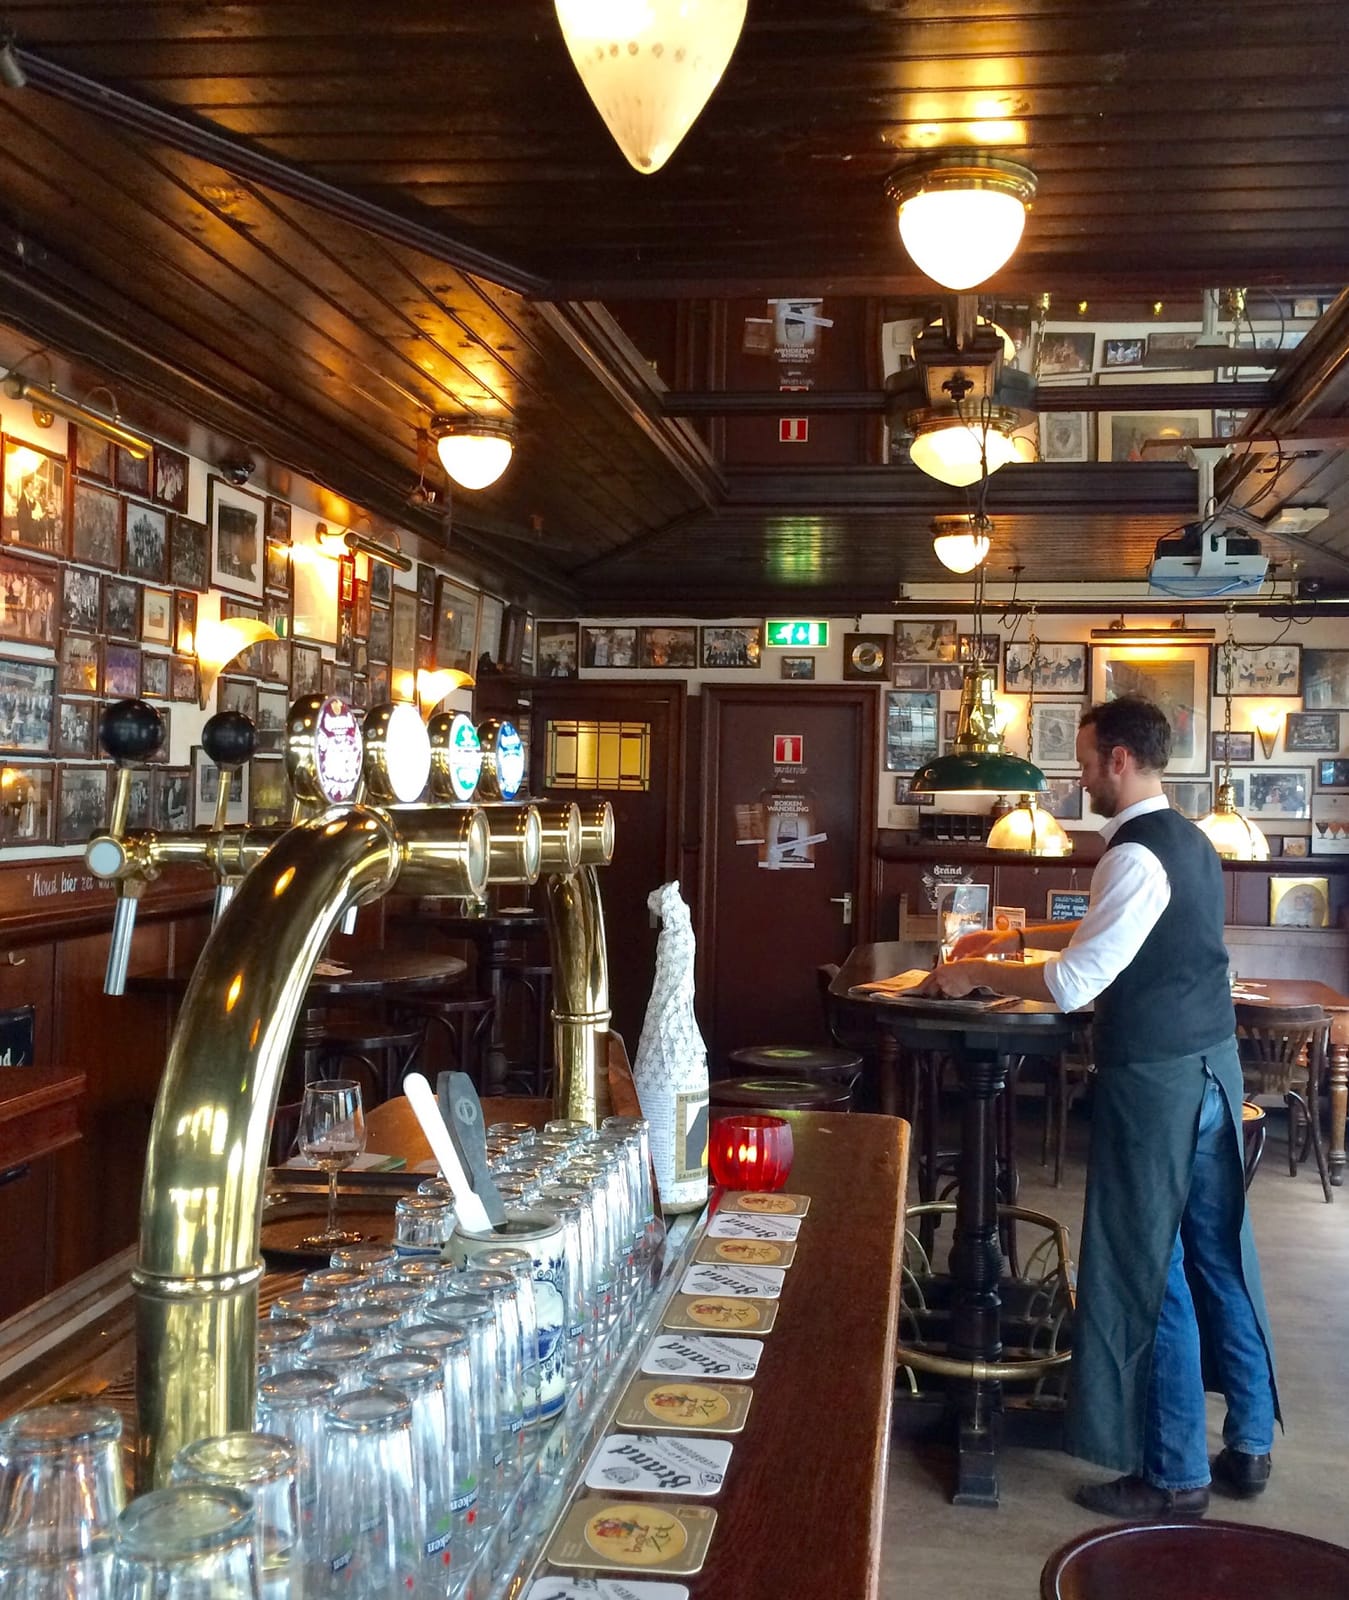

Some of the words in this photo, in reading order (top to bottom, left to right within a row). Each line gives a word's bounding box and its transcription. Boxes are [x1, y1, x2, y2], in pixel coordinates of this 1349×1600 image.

[934, 865, 962, 875] Brand
[720, 1217, 780, 1239] Brand
[694, 1268, 760, 1295] Brand
[658, 1341, 732, 1375] Brand
[607, 1443, 692, 1489] Brand
